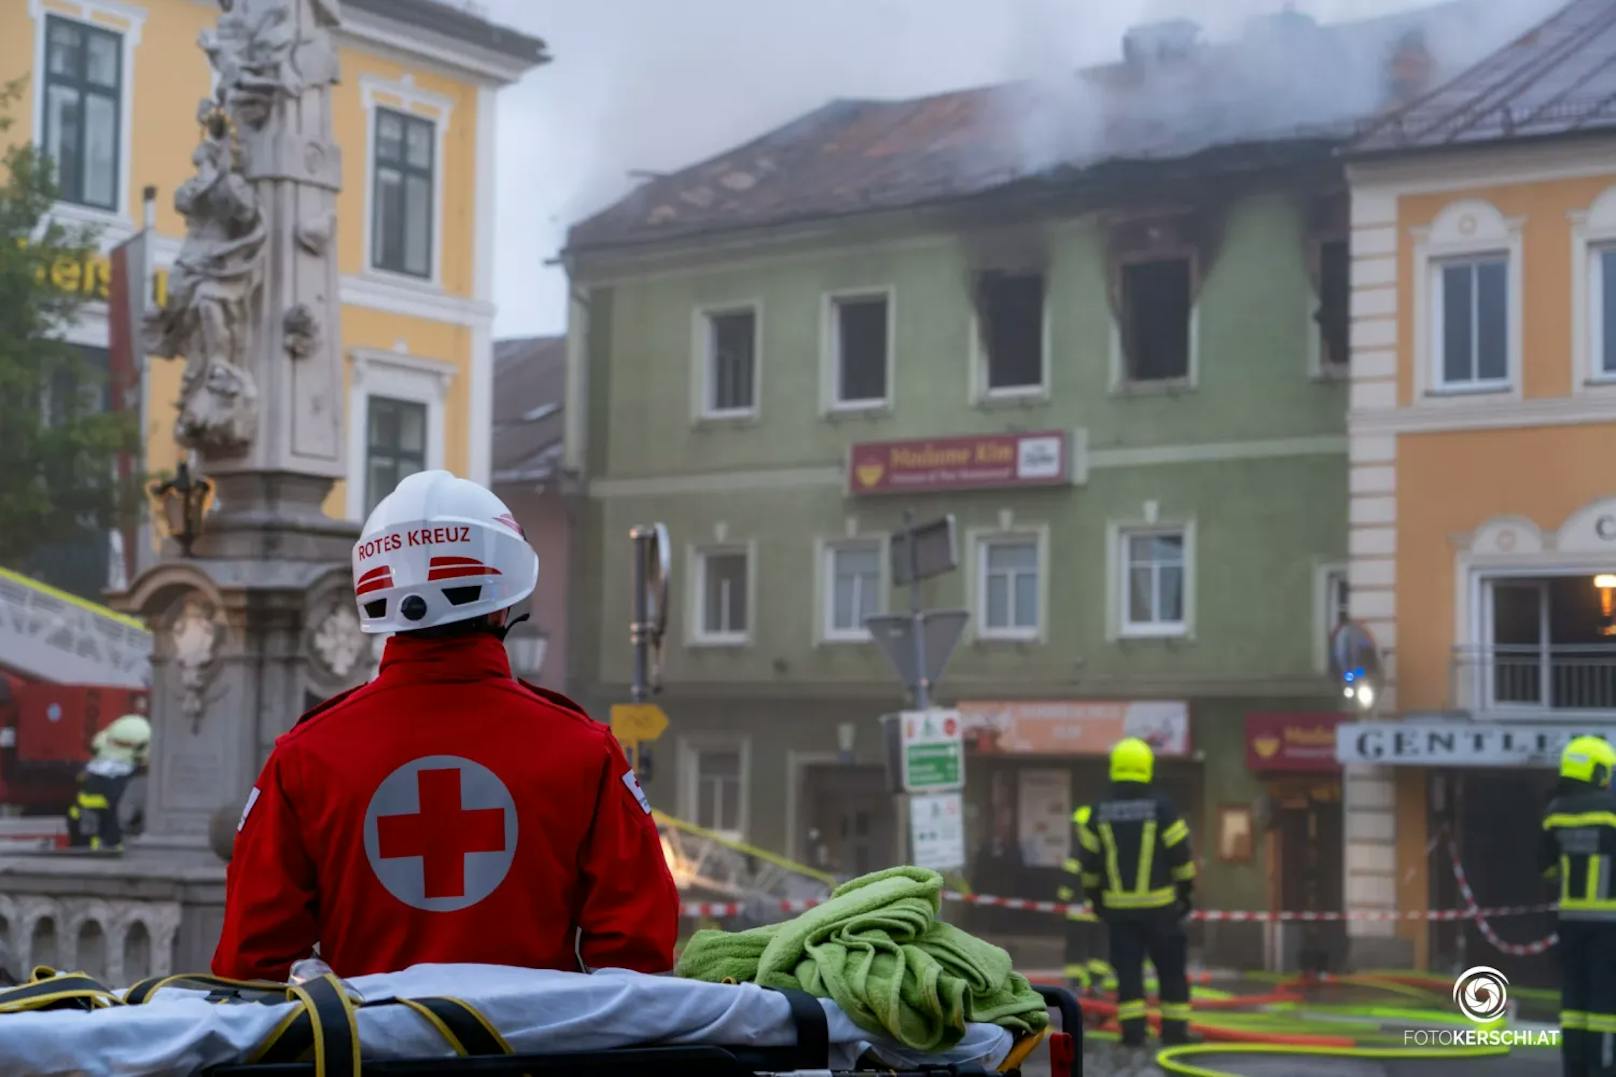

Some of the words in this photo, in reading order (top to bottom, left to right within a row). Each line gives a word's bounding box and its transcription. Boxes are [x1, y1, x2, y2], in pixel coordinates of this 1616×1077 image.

[358, 534, 402, 561] ROTES
[408, 526, 471, 547] KREUZ
[1356, 727, 1600, 759] GENTLE
